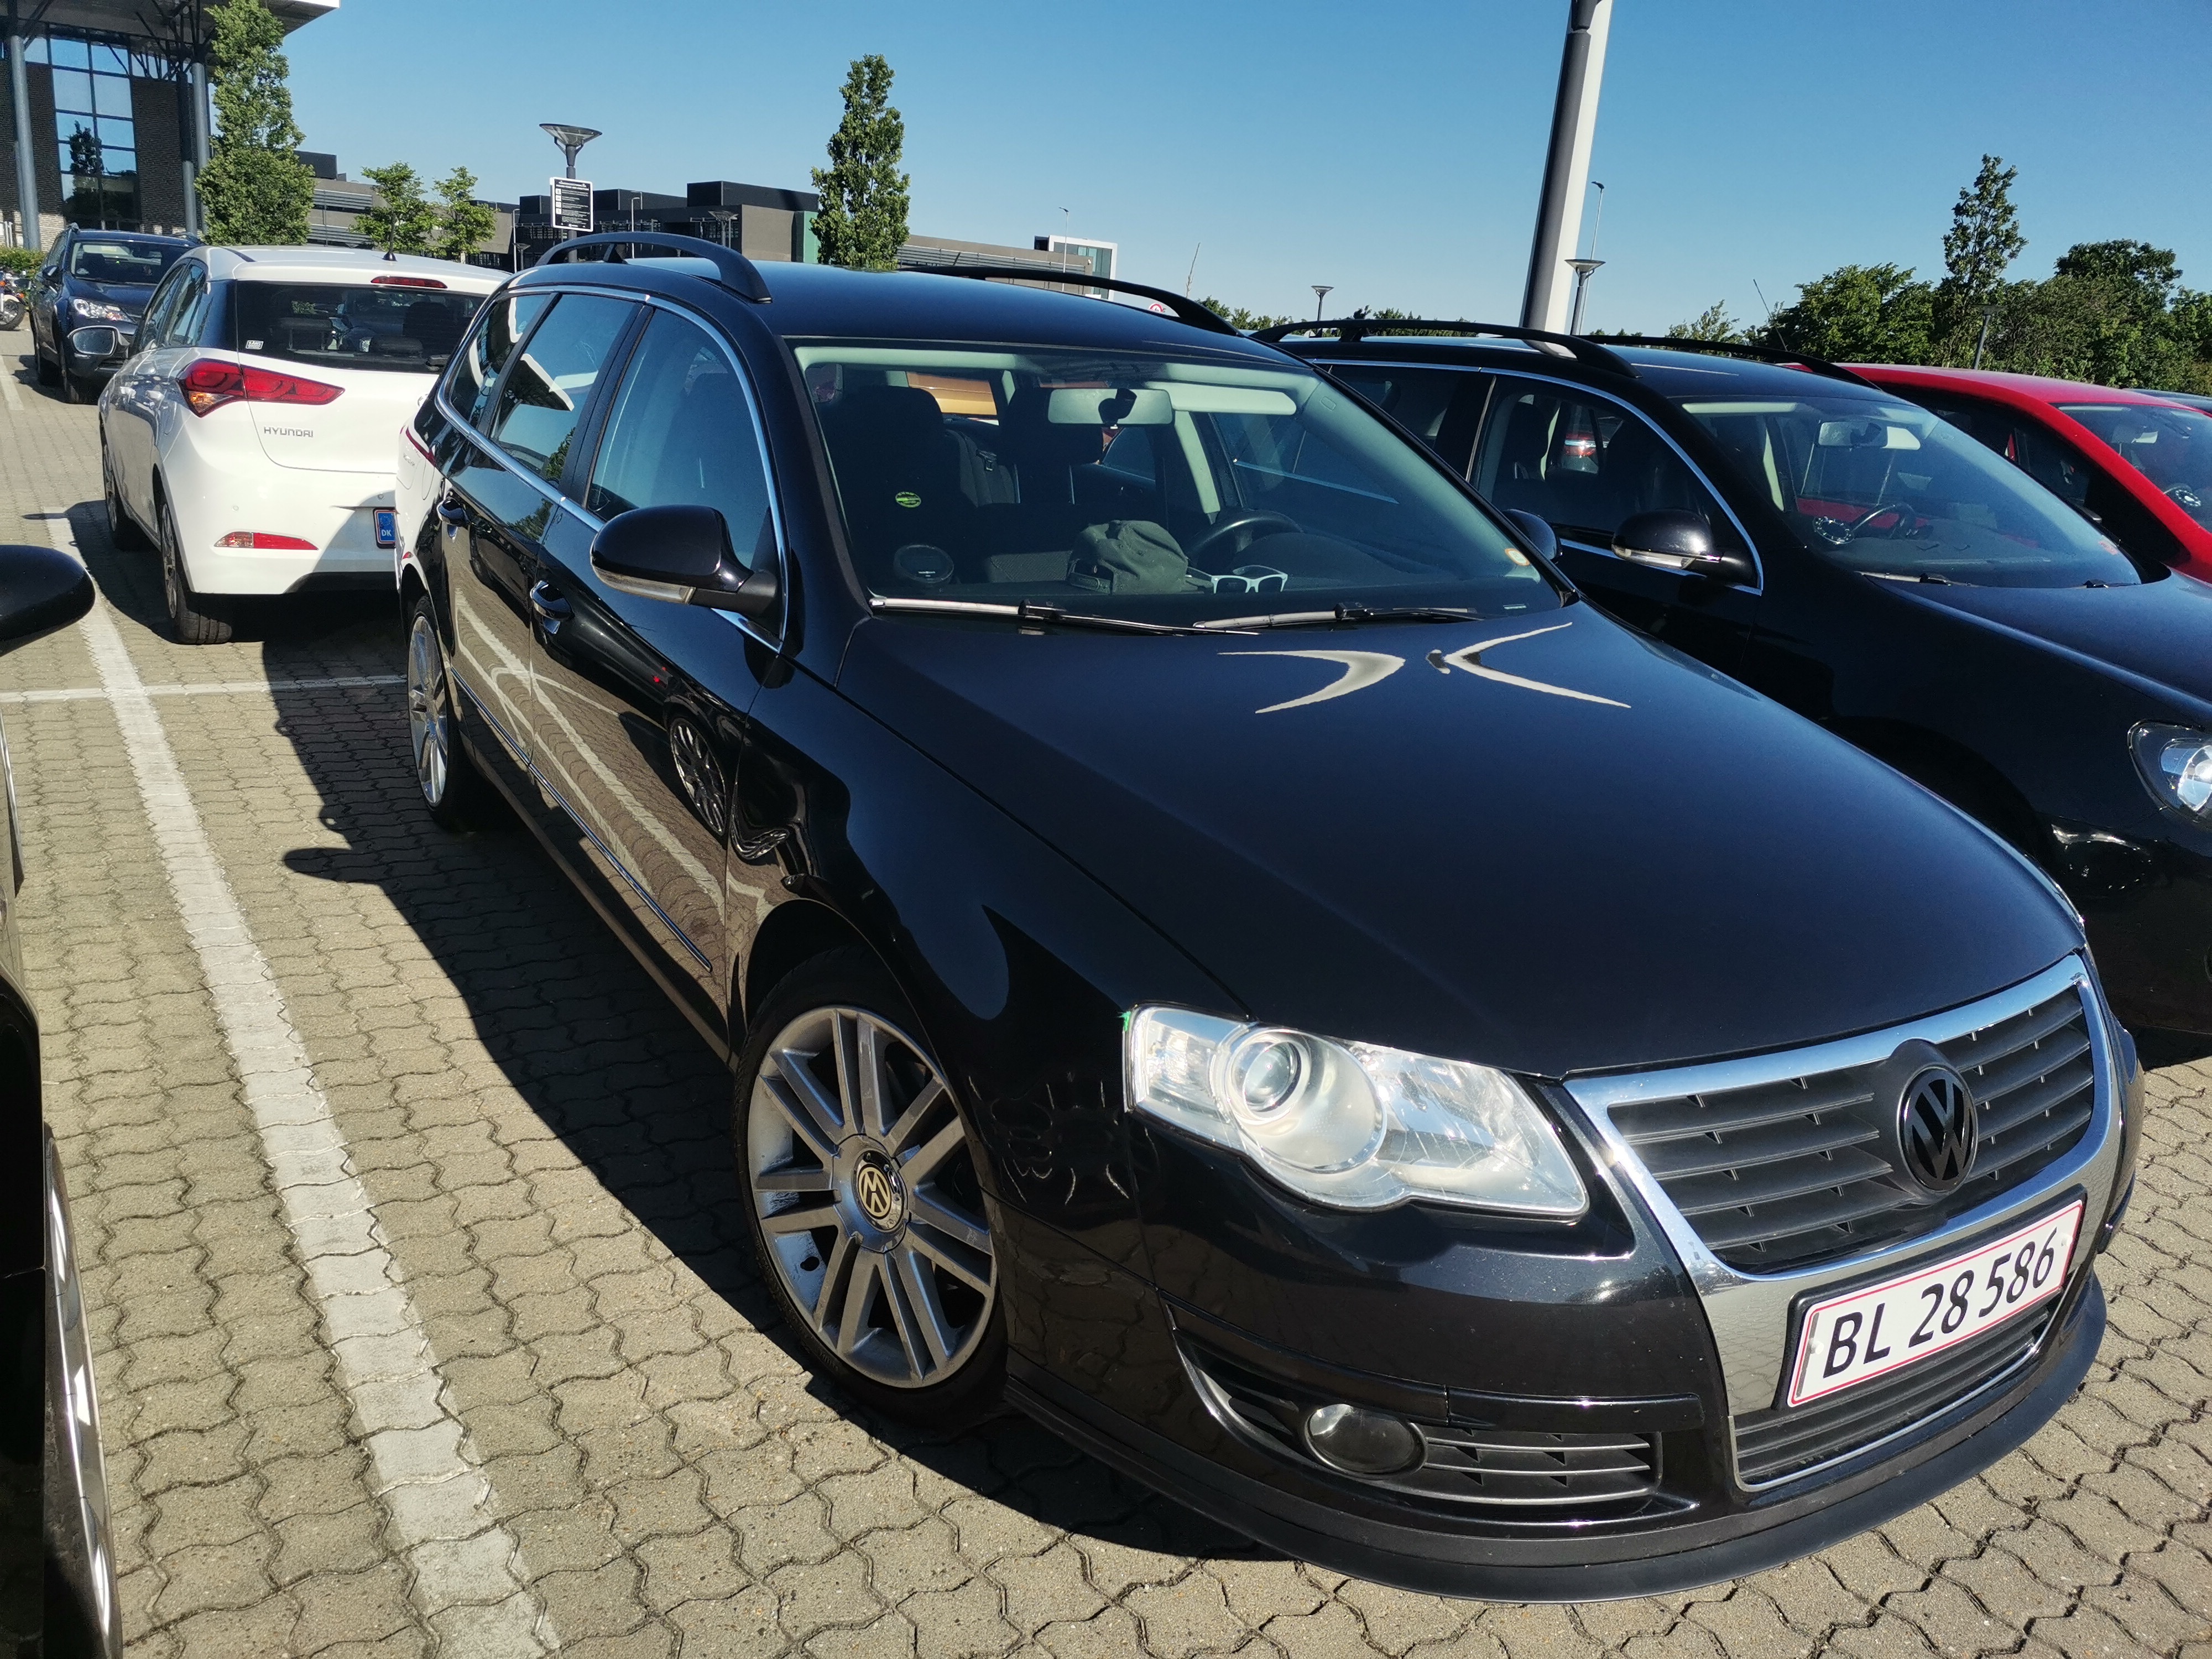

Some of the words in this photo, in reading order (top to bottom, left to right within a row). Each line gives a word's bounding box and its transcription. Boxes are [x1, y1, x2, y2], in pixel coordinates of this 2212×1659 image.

[264, 426, 314, 437] HYUNDAI
[1823, 1302, 1891, 1379] BL
[1908, 1269, 1975, 1348] 28
[1978, 1227, 2058, 1318] 586
